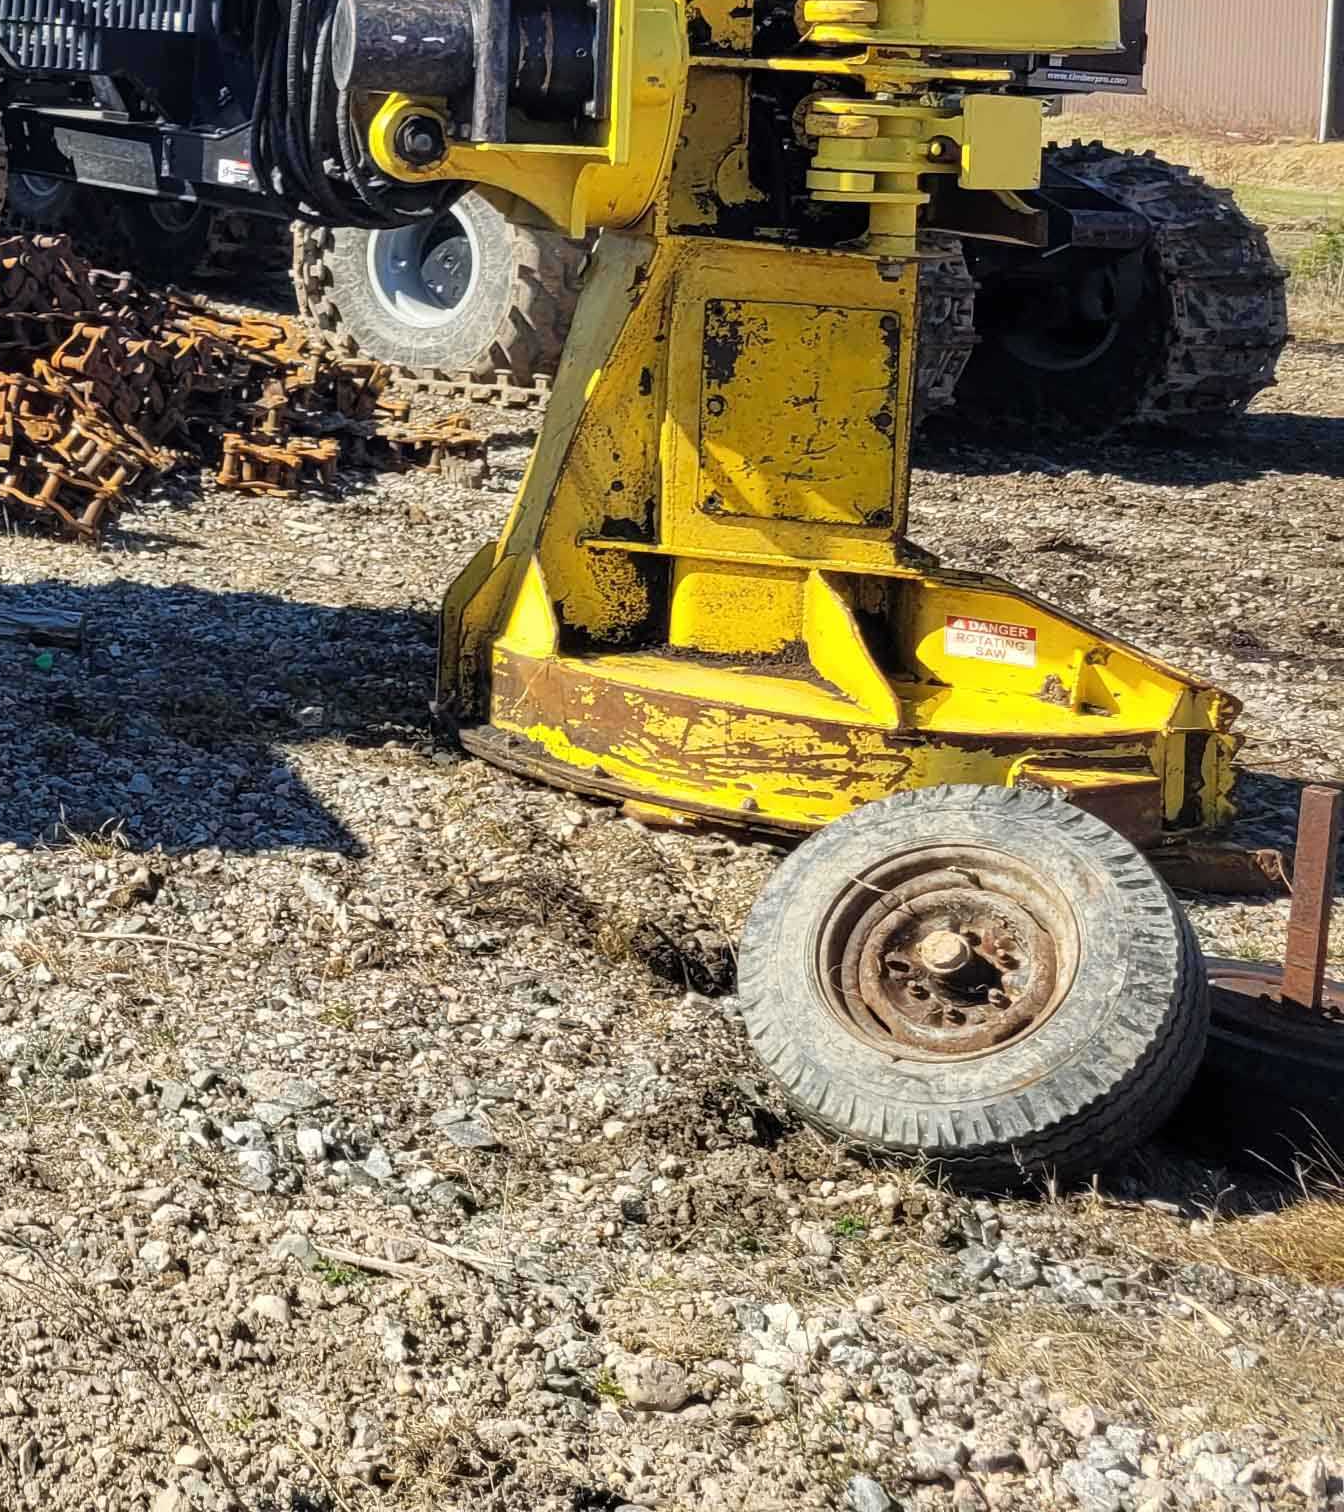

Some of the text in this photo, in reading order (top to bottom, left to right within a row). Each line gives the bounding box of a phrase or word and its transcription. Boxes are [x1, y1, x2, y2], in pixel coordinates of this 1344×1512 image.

[967, 620, 1029, 638] DANGER
[956, 631, 1025, 651] ROTATING
[975, 646, 1007, 659] SAW
